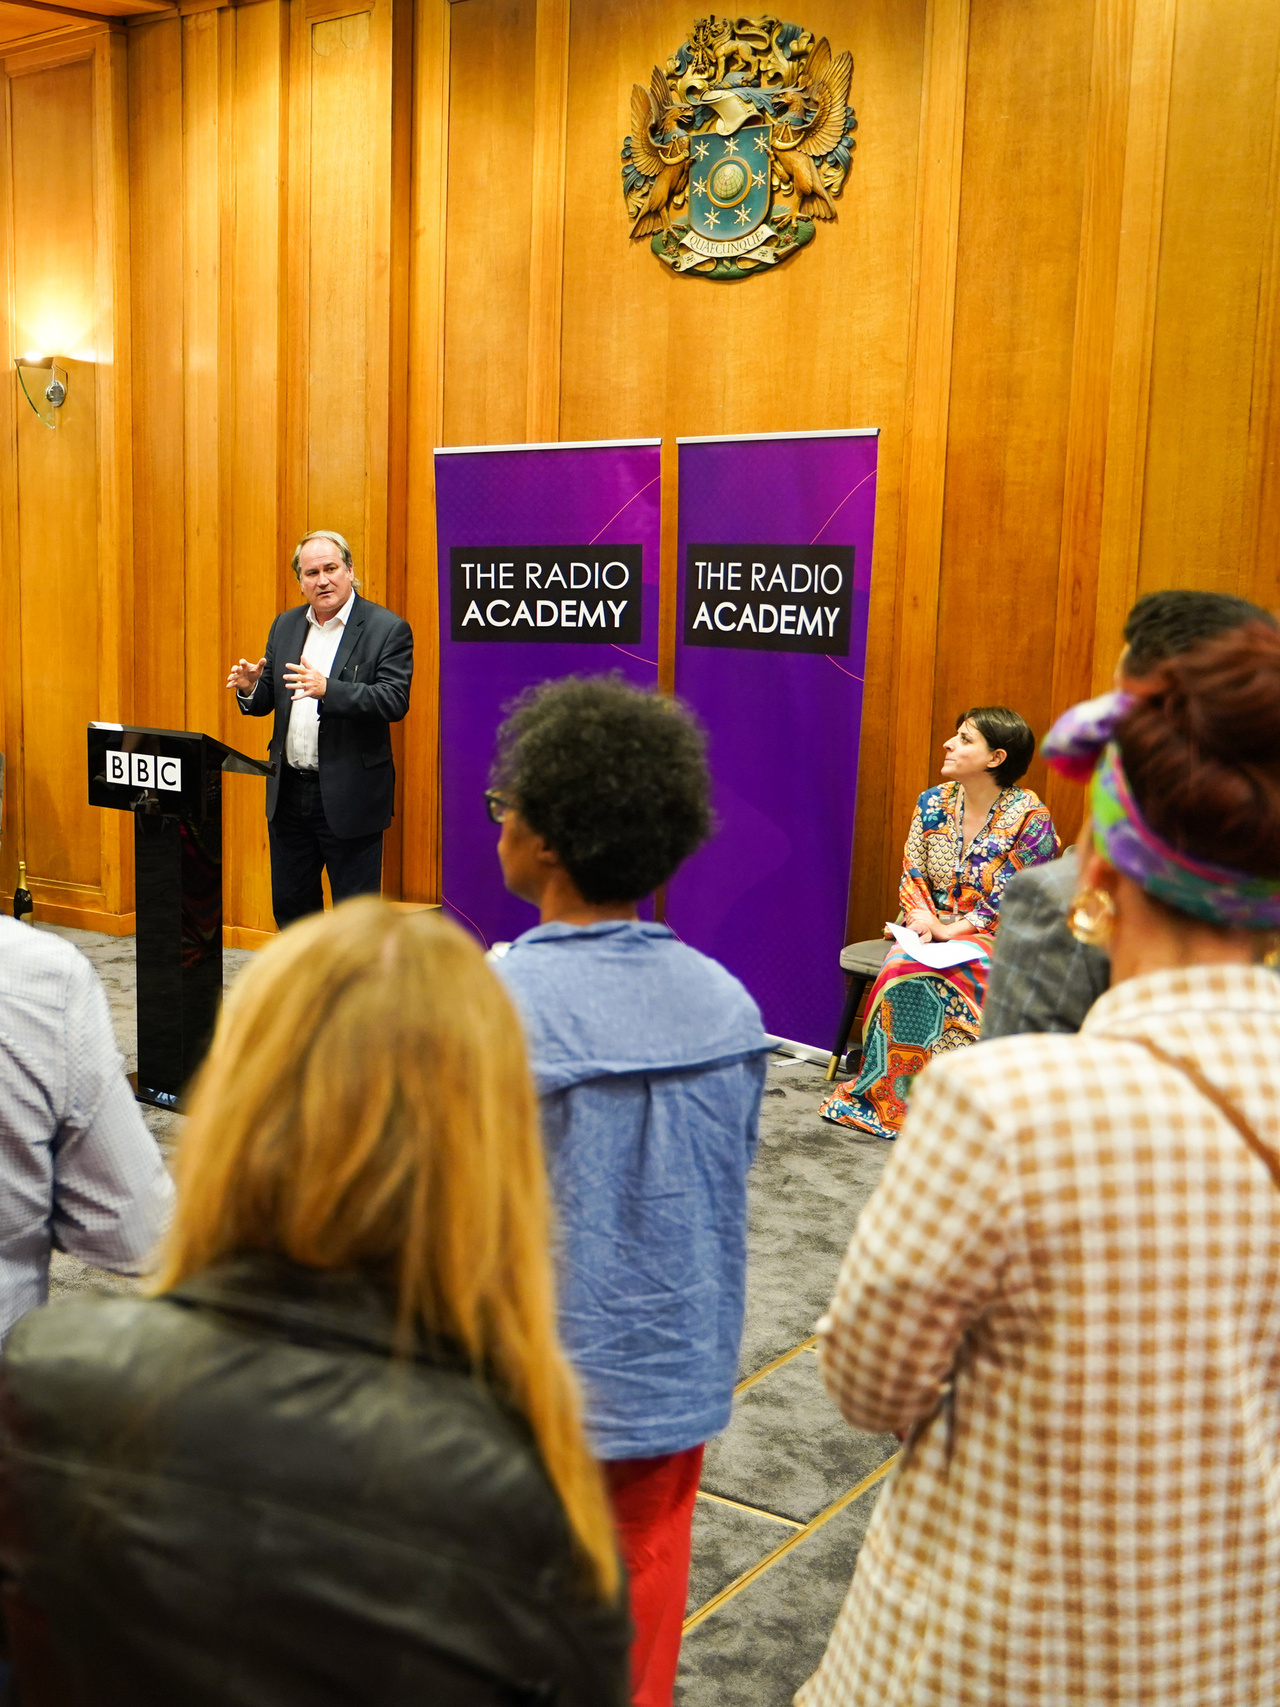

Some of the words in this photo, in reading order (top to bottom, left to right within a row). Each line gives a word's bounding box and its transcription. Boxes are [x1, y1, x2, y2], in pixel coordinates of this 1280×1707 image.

[689, 231, 763, 254] QUAECUNQUE
[460, 562, 514, 590] THE
[525, 561, 630, 590] RADIO
[694, 561, 743, 591] THE
[750, 562, 843, 595] RADIO
[461, 599, 628, 628] ACADEMY
[692, 601, 841, 638] ACADEMY
[110, 754, 178, 788] BBC
